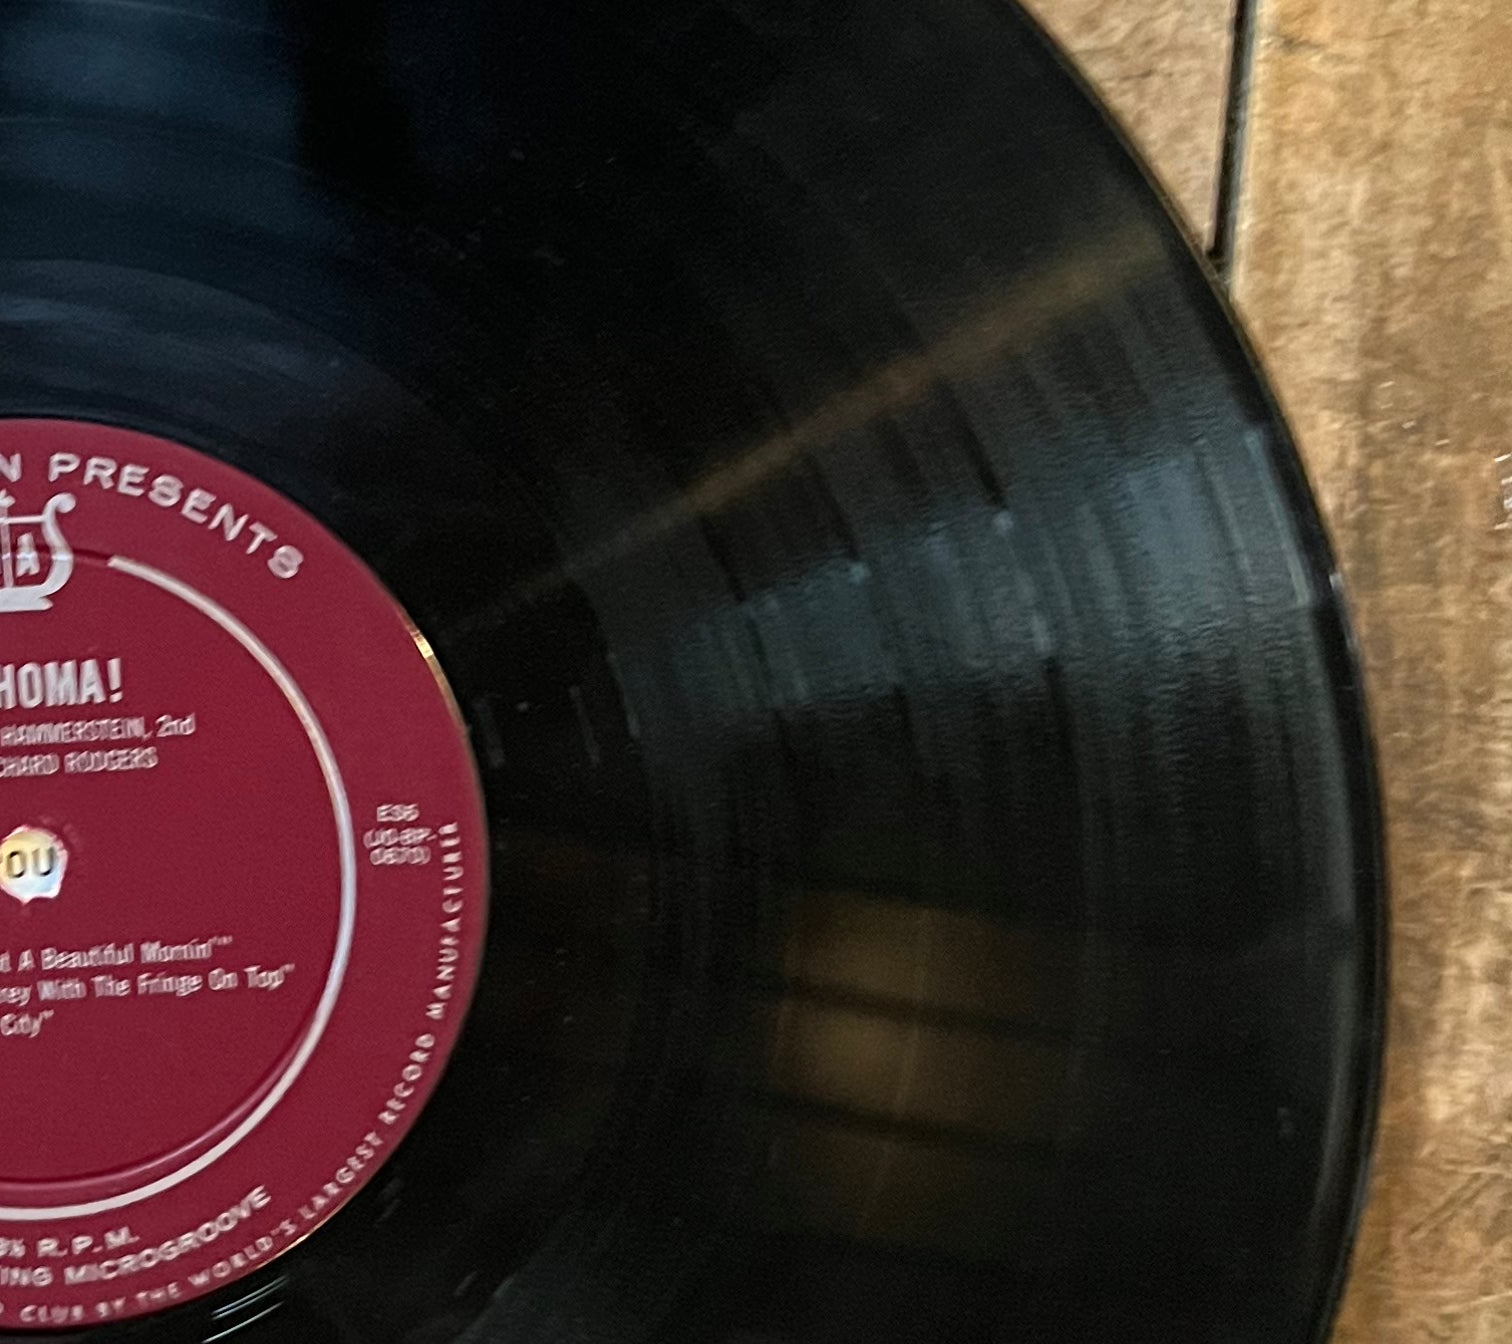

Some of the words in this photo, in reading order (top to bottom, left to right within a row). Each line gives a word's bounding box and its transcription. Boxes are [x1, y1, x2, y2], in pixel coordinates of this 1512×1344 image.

[48, 452, 305, 579] PRESENTS
[155, 712, 197, 738] 2nd
[64, 747, 158, 774] RODGERS
[17, 949, 36, 972] A
[40, 942, 134, 970] Beautiful
[37, 977, 87, 1002] With
[91, 973, 131, 998] The
[137, 971, 203, 997] Fringe
[208, 967, 238, 991] On
[135, 1282, 183, 1301] THE
[298, 1130, 384, 1221] LARGEST
[378, 1033, 436, 1125] RECORD
[64, 1184, 272, 1285] MICROGROOVE
